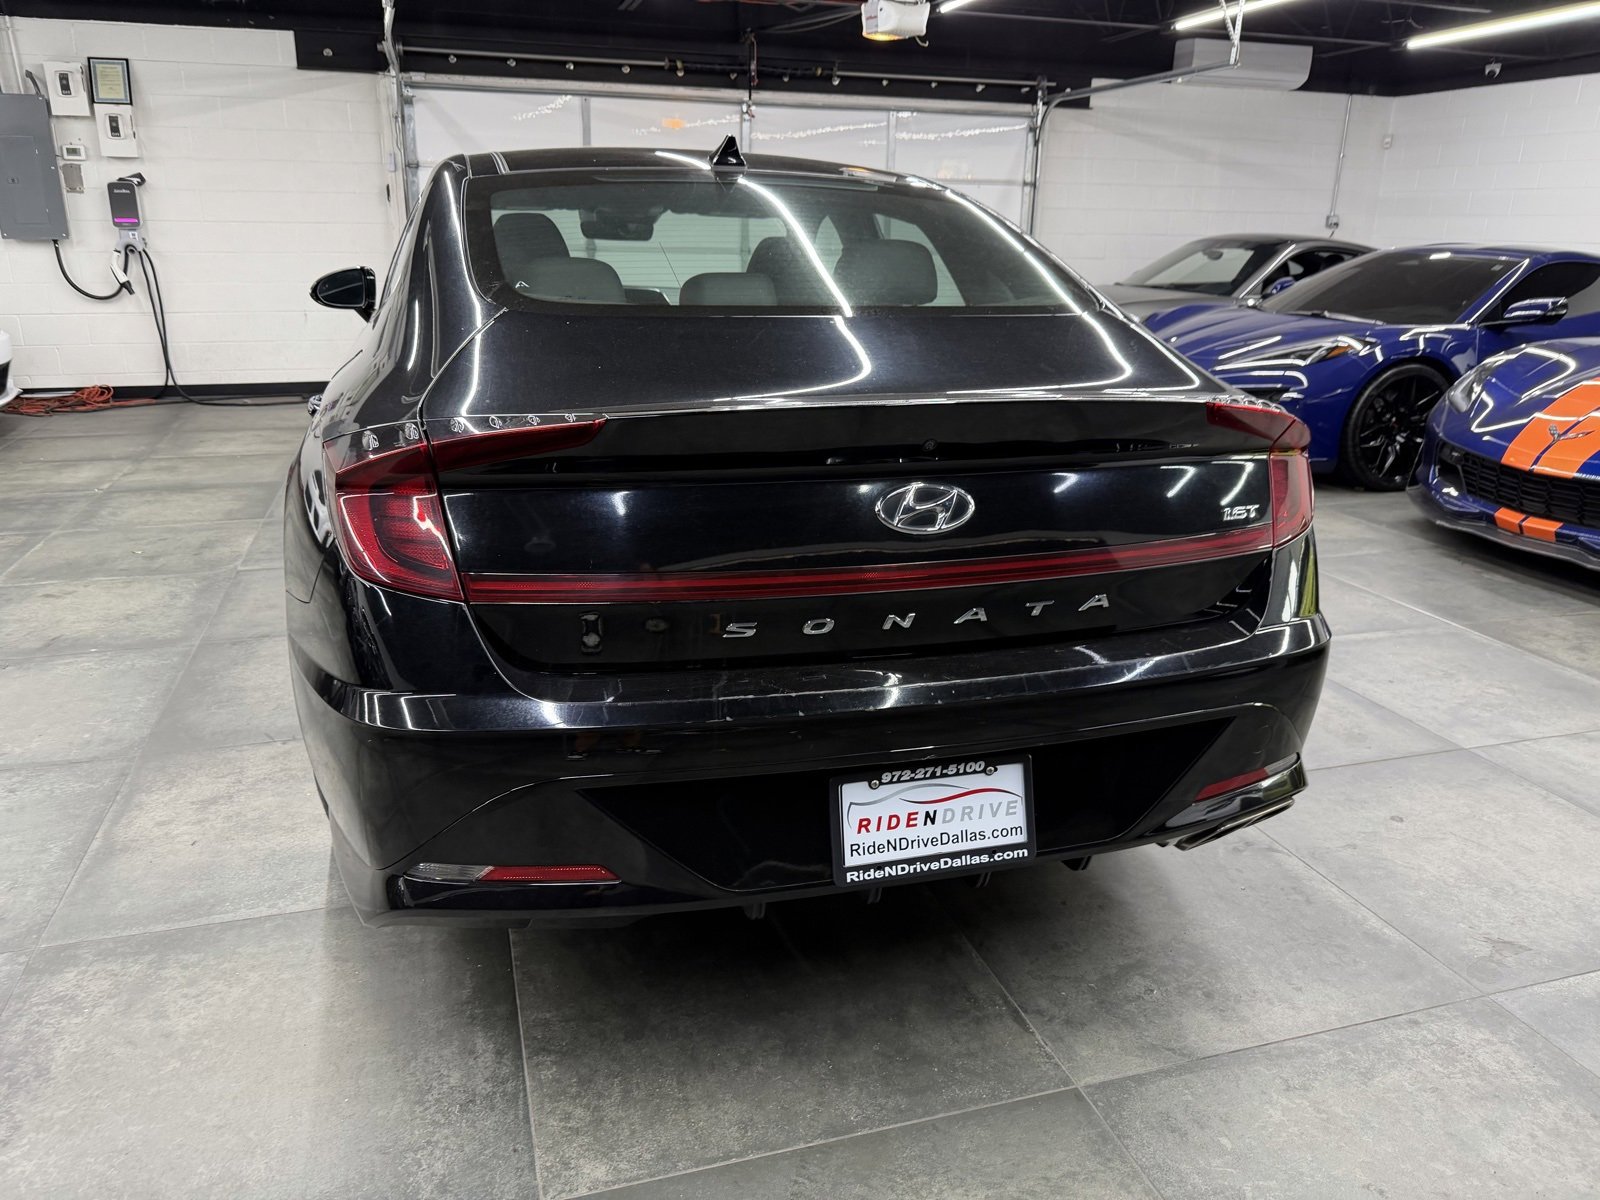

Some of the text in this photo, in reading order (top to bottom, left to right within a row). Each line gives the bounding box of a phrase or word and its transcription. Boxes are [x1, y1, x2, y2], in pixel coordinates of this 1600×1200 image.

[722, 594, 1110, 638] SONATA
[881, 761, 985, 783] 972-271-5100
[857, 800, 1018, 834] RIDENDRIVE
[850, 825, 1023, 857] RideNDriveDallas.com
[846, 849, 1028, 883] RideNDriveDallas.com
